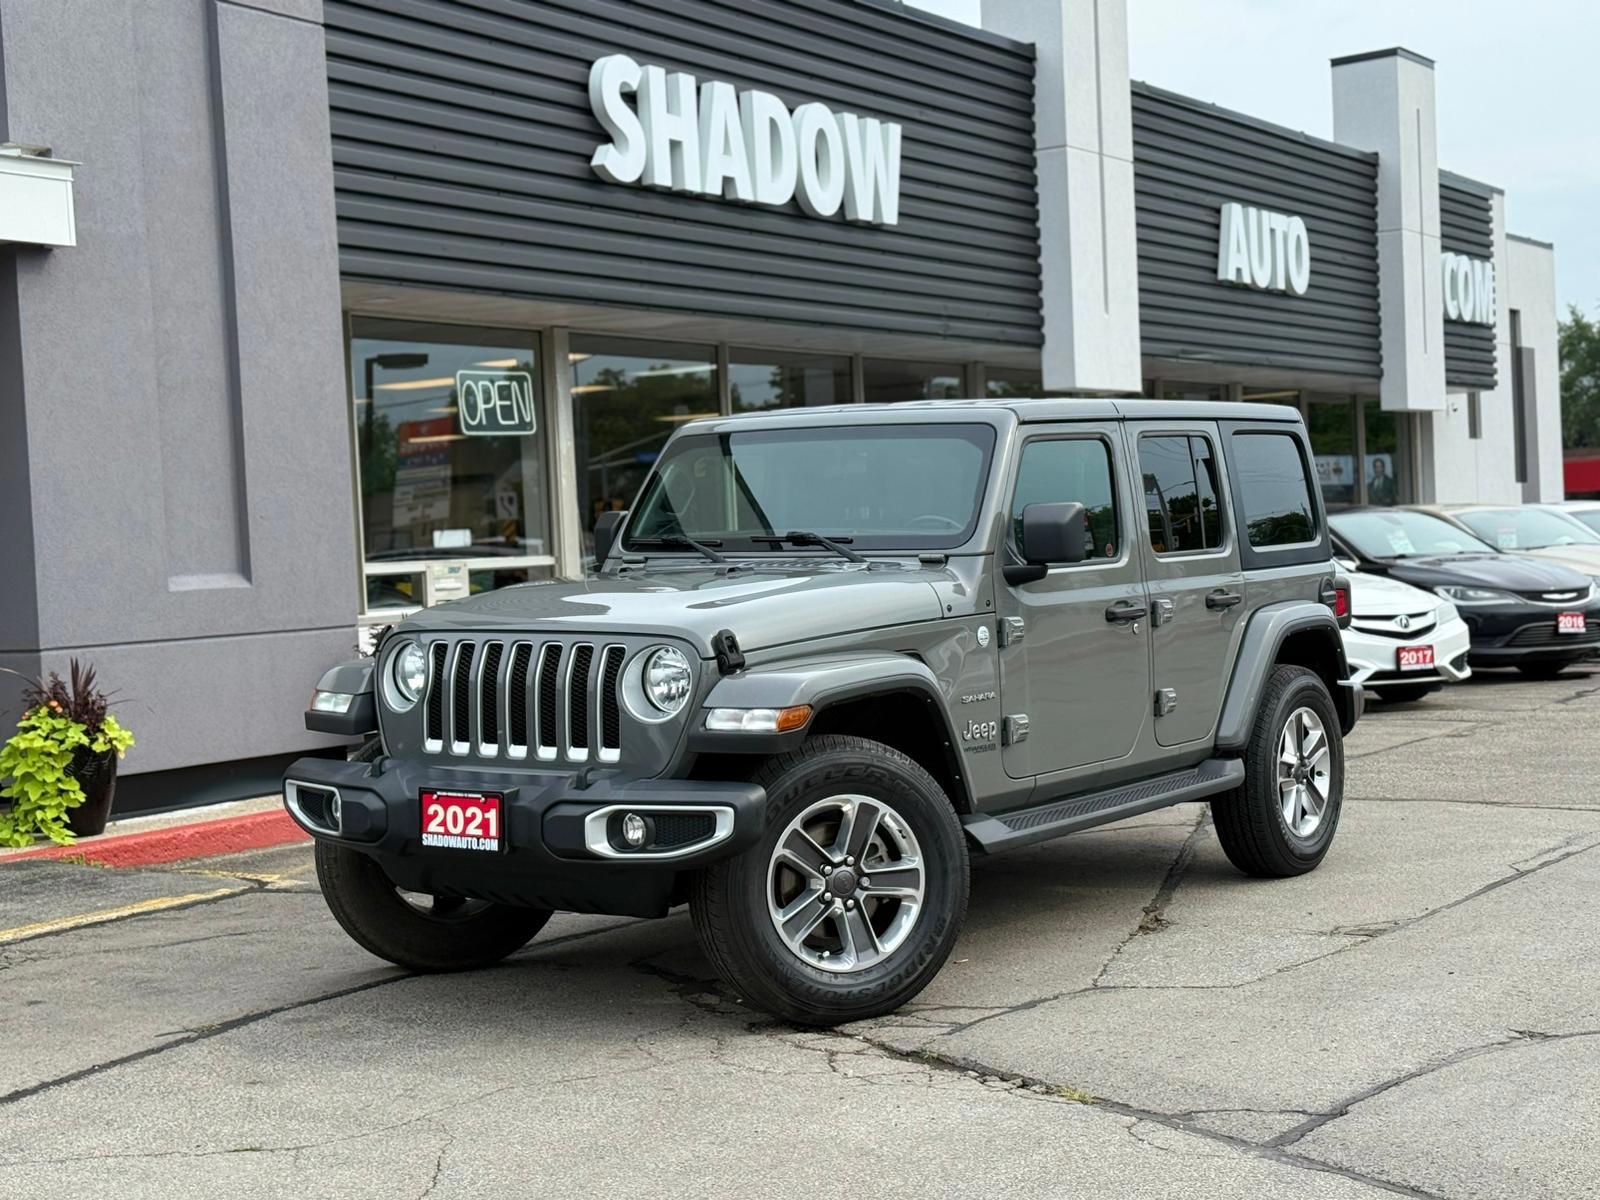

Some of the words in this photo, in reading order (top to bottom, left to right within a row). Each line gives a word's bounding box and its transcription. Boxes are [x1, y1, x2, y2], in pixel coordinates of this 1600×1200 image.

[588, 54, 902, 225] SHADOW
[1217, 202, 1310, 296] AUTO
[1440, 252, 1494, 325] COM
[461, 380, 531, 426] OPEN
[1400, 649, 1432, 664] 2017
[962, 691, 997, 704] SAHARA
[962, 720, 997, 741] Jeep
[963, 743, 997, 753] WRANGLER
[427, 803, 497, 837] 2021
[422, 833, 499, 852] SHADOWAUTO.COM
